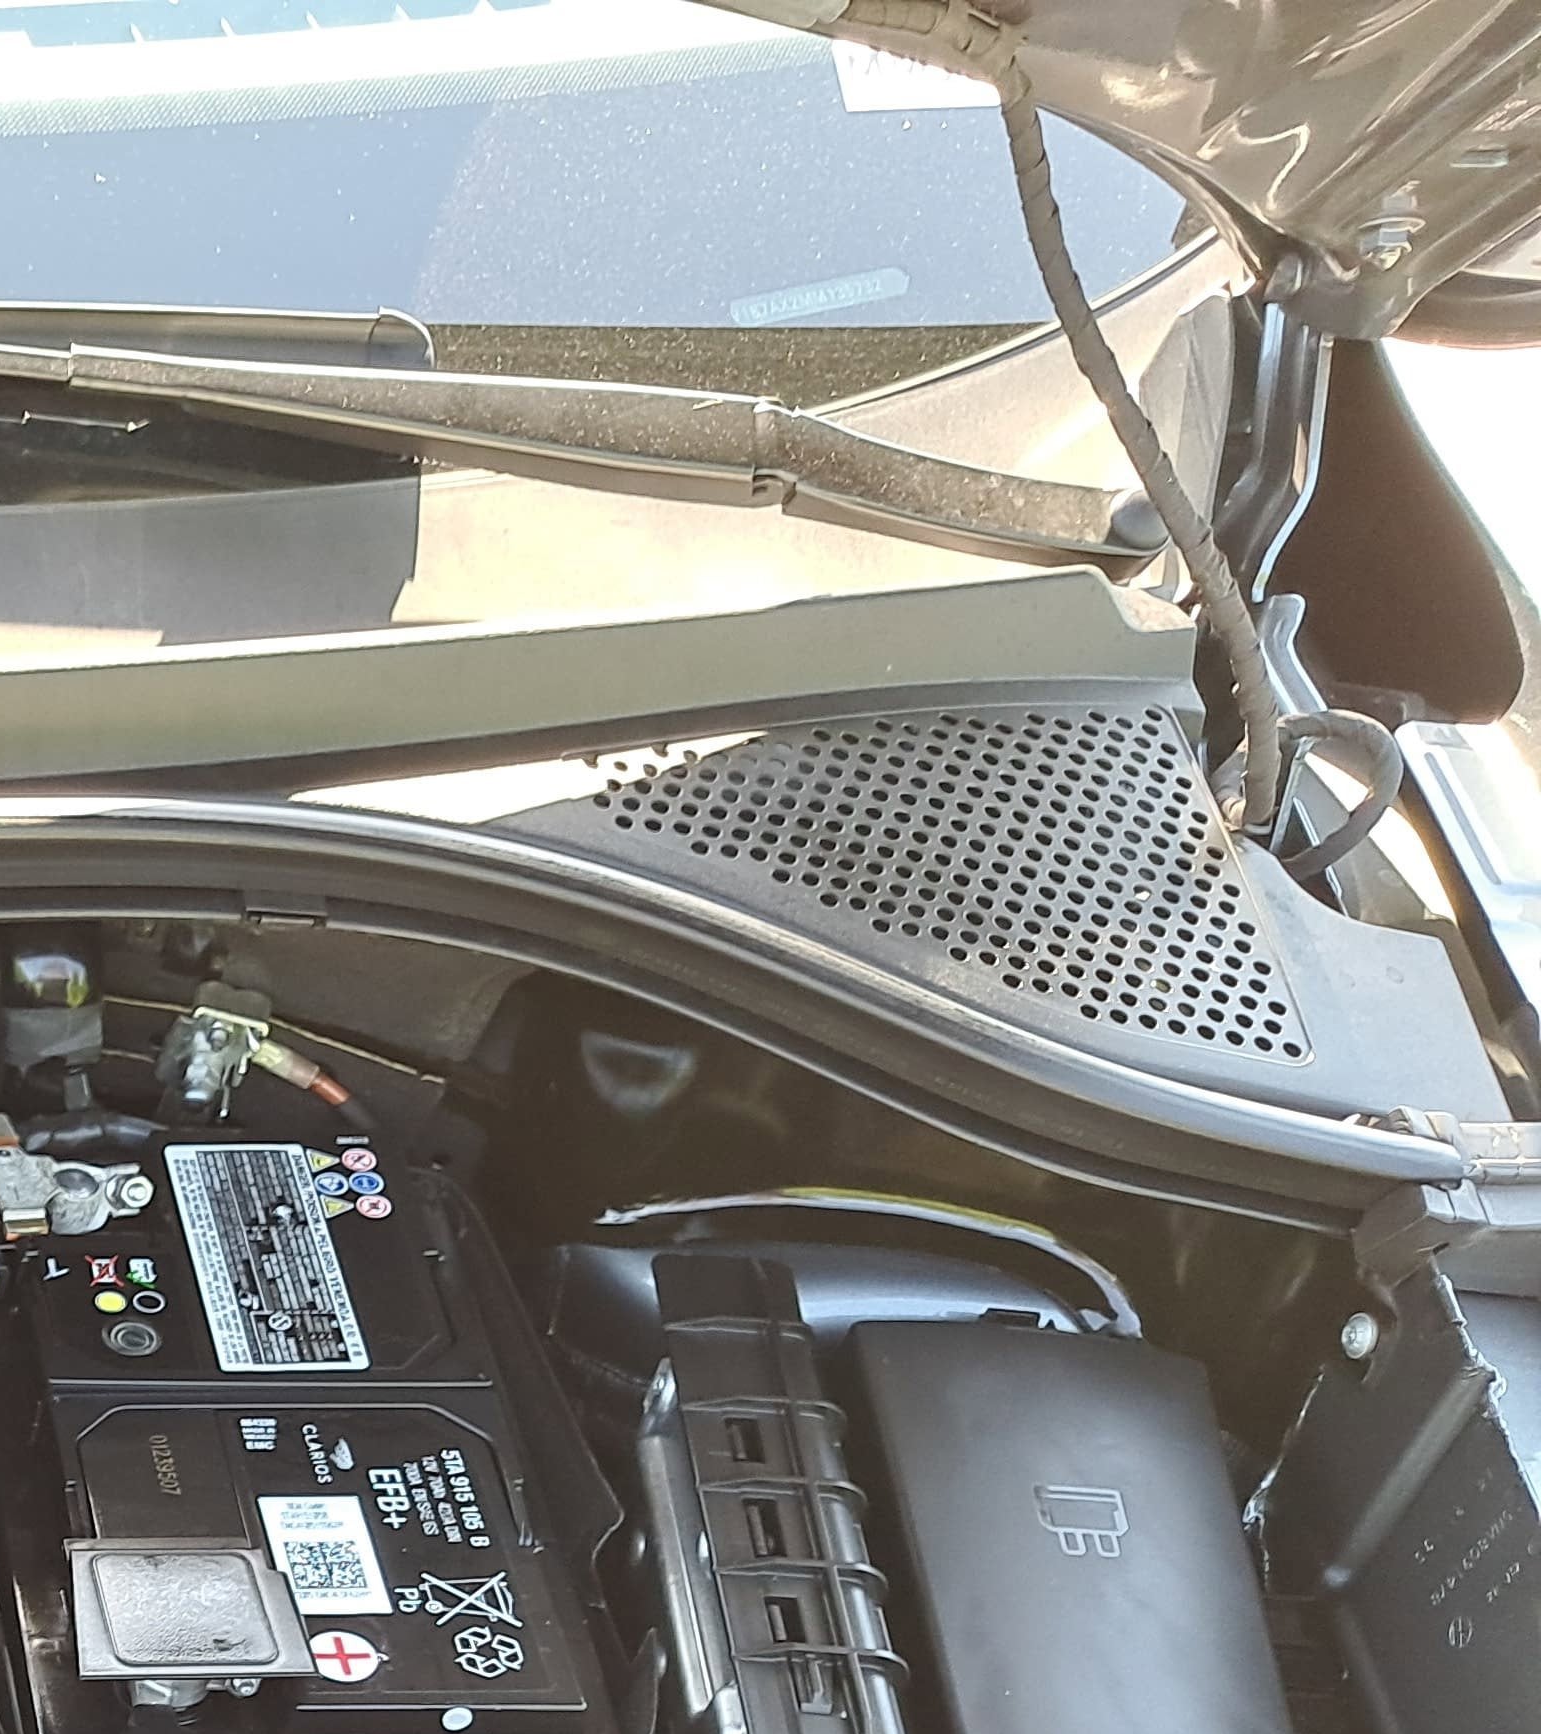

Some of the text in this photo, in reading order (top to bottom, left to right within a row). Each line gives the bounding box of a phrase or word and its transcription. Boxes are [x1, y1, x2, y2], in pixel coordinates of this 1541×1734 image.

[301, 1424, 333, 1485] CLARIOS
[367, 1468, 411, 1530] EFB+
[449, 1476, 475, 1502] 915
[459, 1504, 485, 1530] 105
[469, 1536, 491, 1547] B
[393, 1587, 423, 1613] Pb
